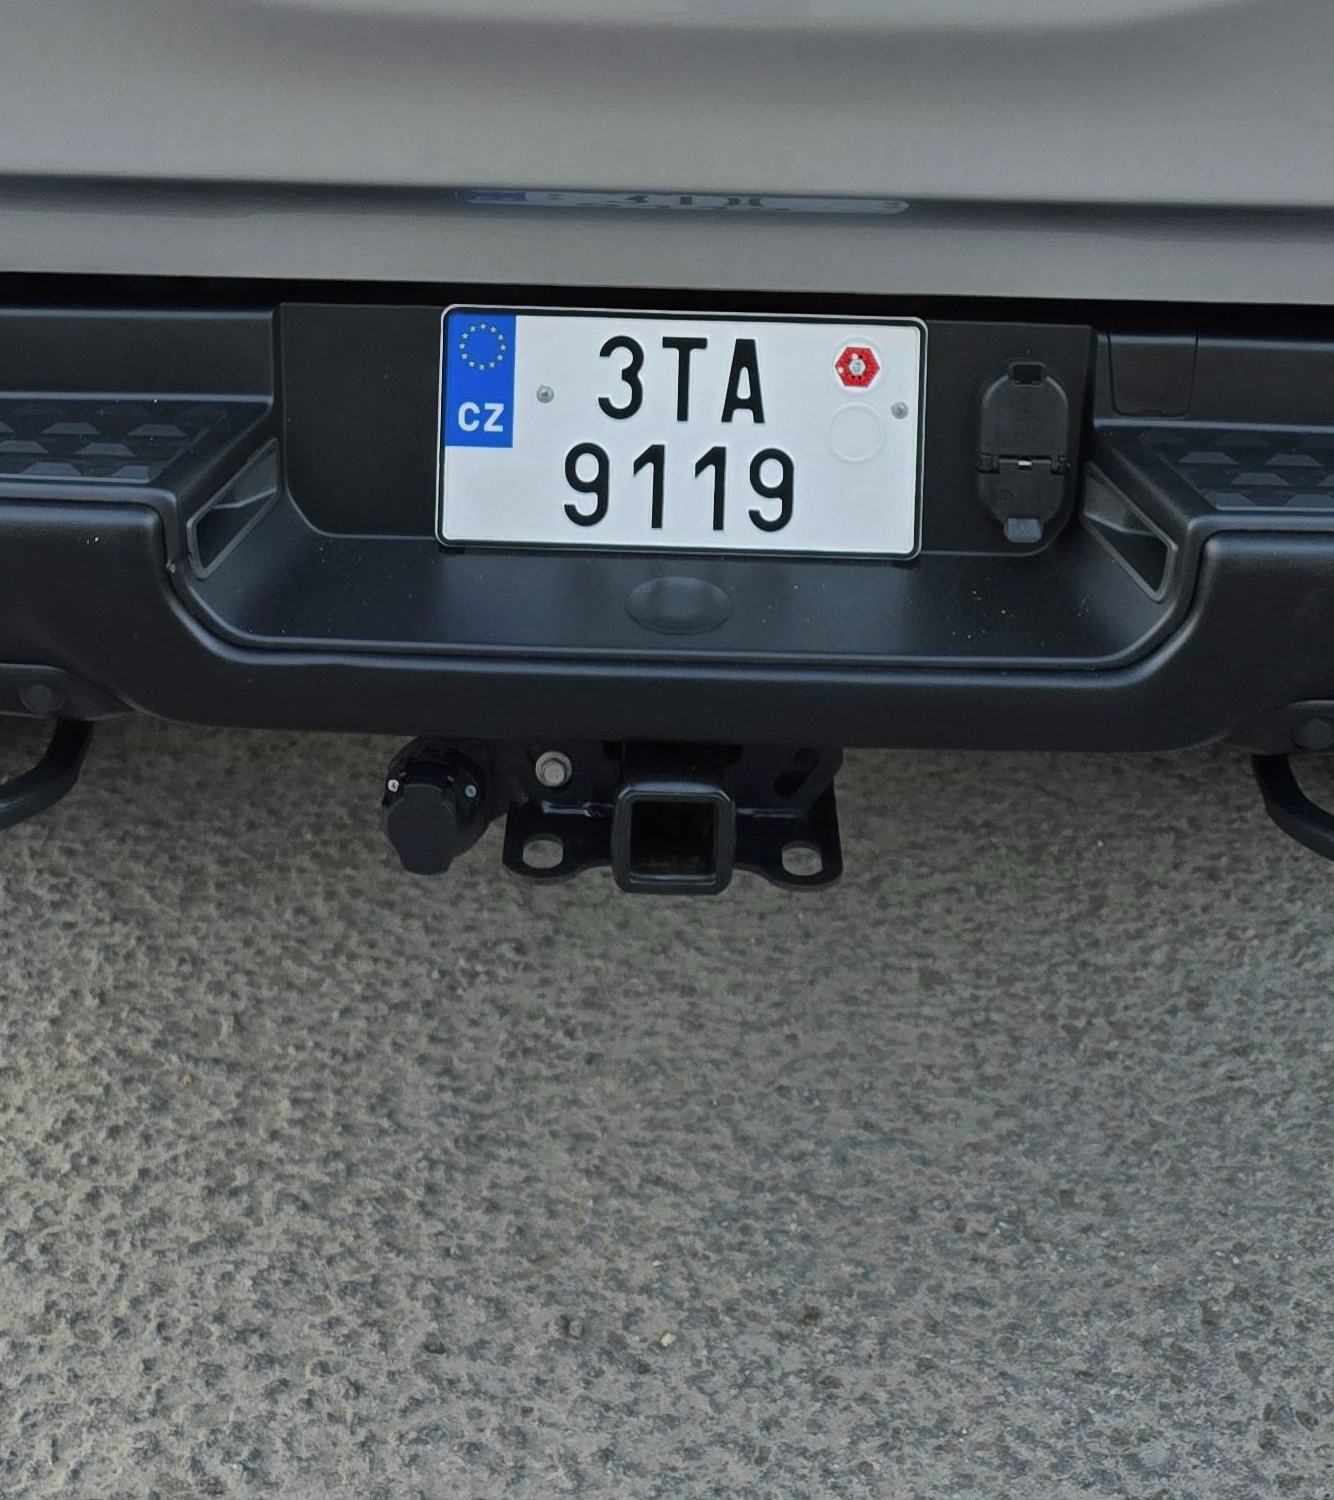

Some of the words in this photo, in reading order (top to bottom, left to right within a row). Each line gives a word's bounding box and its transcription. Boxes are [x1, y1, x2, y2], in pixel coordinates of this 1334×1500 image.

[457, 402, 505, 434] CZ
[597, 334, 766, 425] 3TA
[563, 441, 796, 533] 9119
